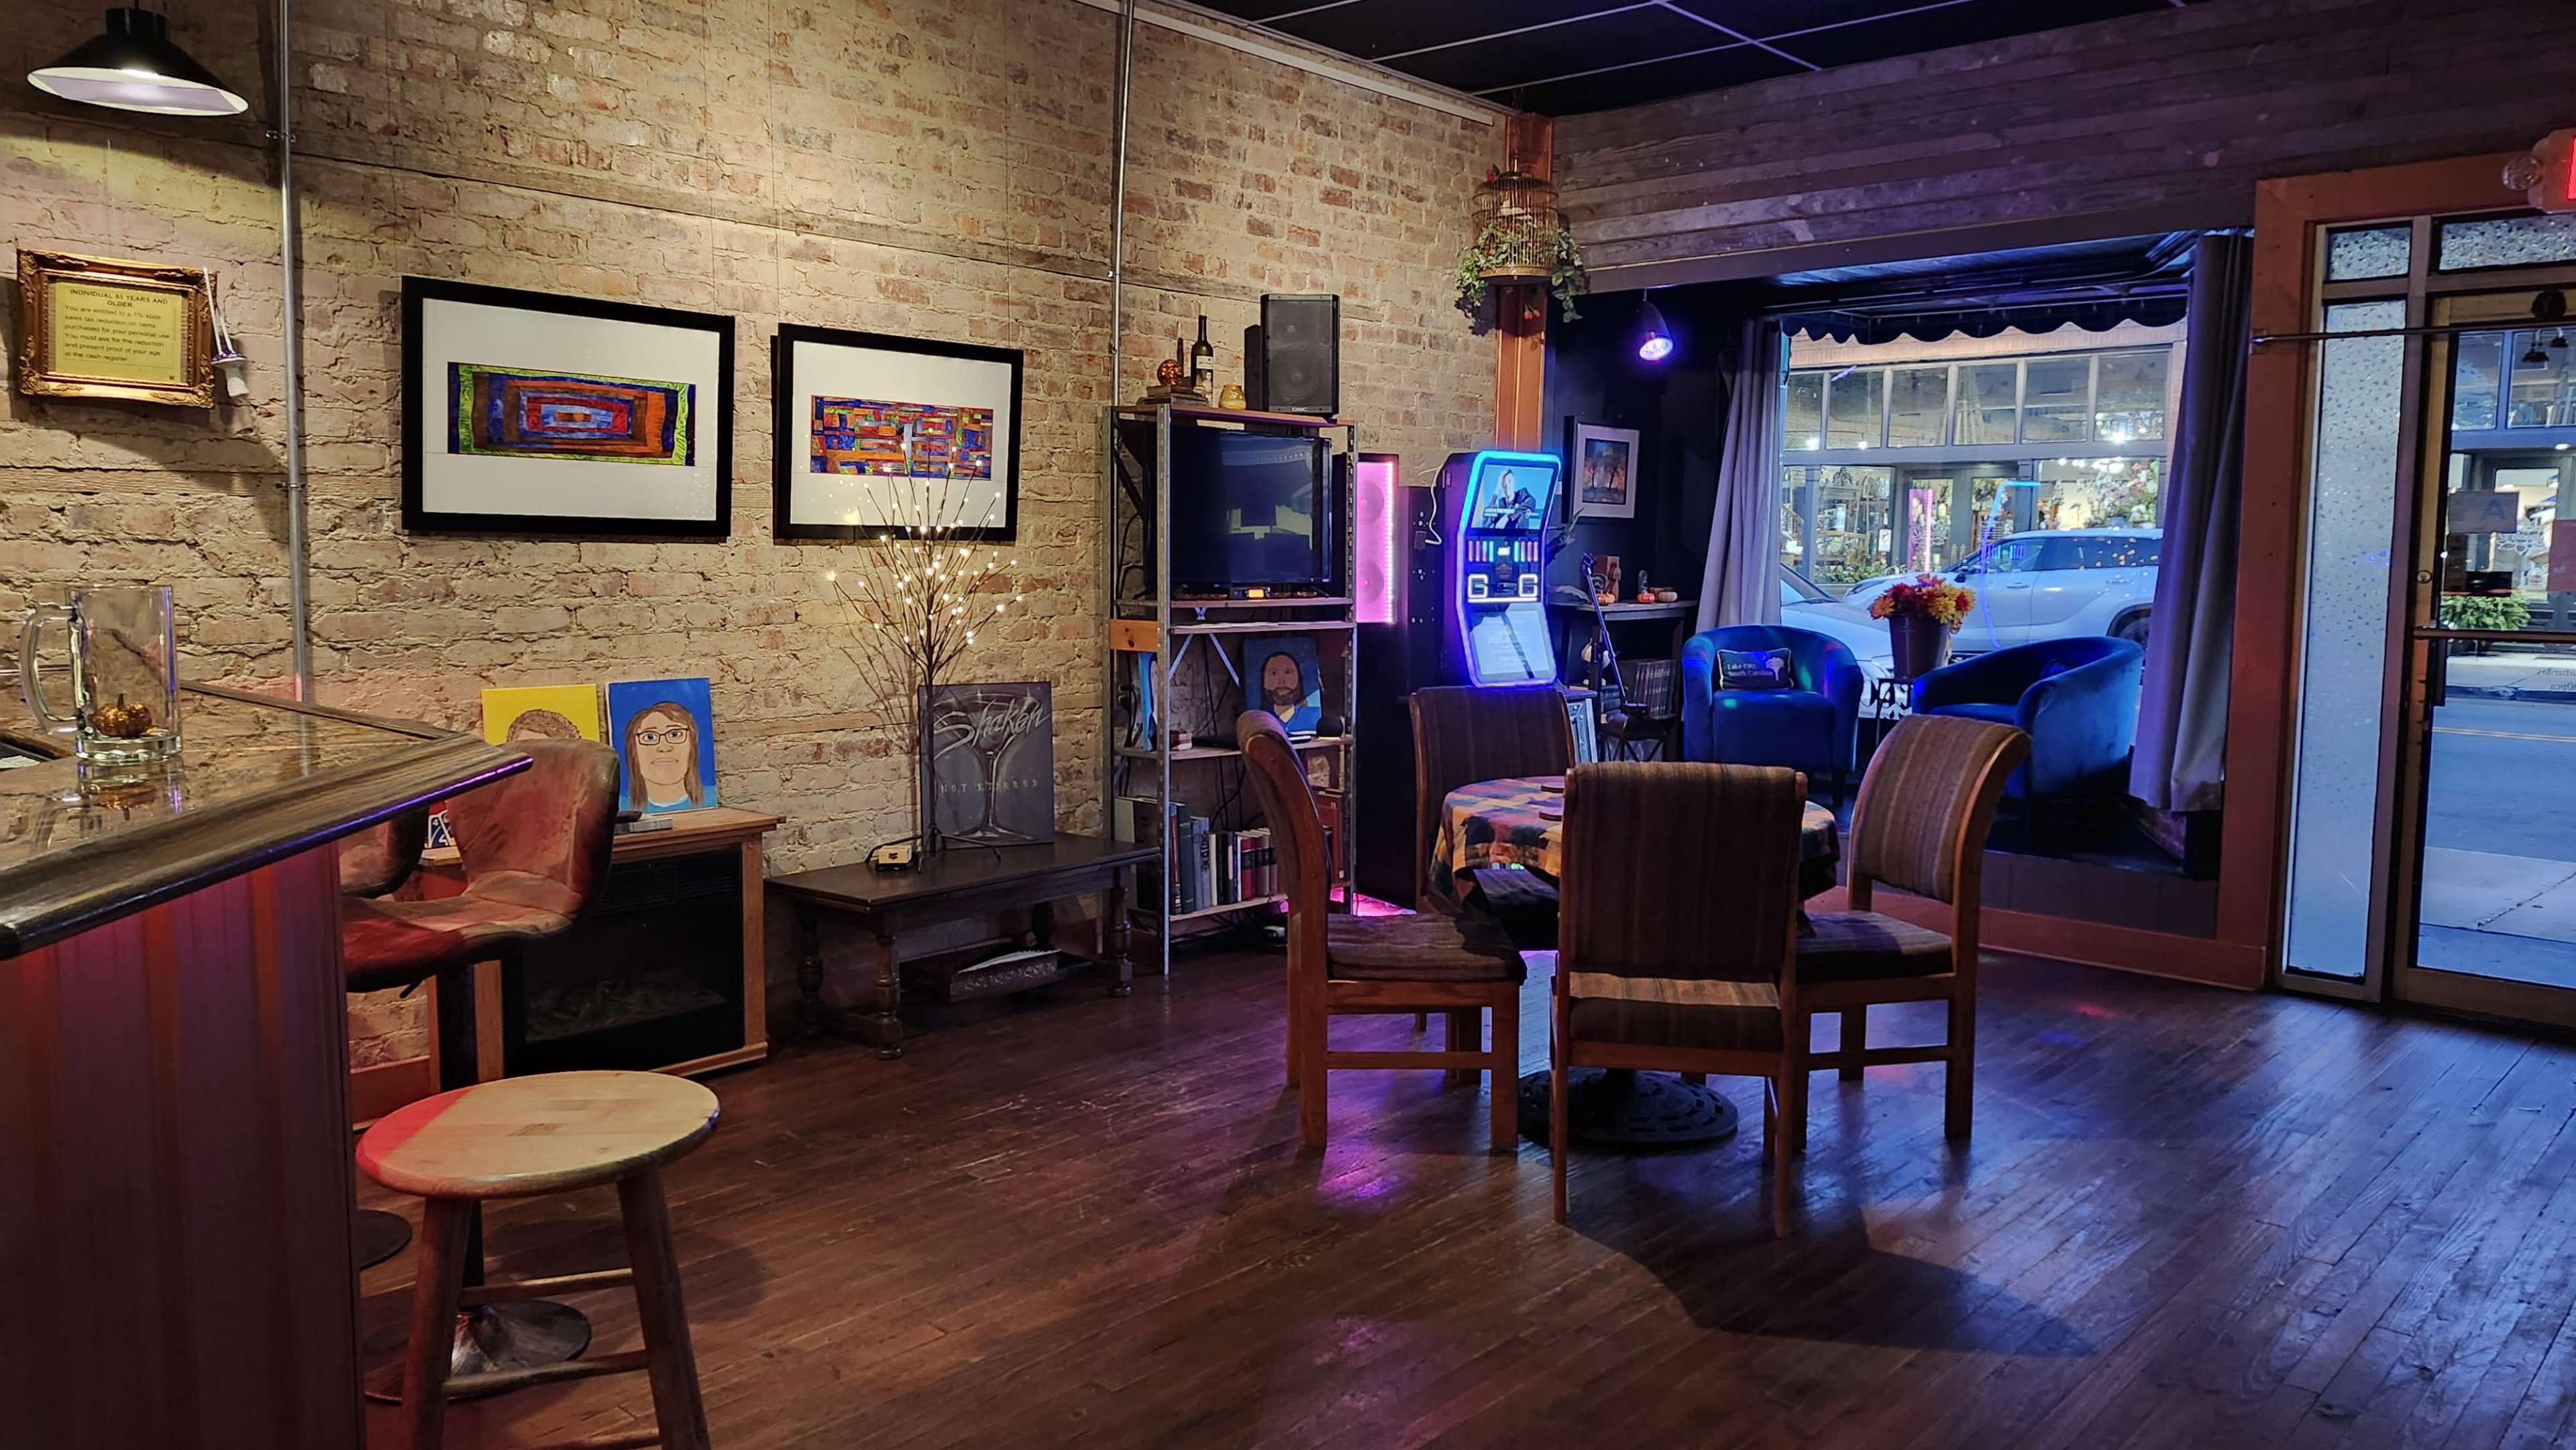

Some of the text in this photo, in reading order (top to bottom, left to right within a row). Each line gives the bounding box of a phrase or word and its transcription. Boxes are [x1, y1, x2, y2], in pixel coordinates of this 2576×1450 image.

[70, 289, 112, 298] INDIVIDUAL
[125, 294, 150, 302] YEARS
[93, 307, 117, 315] entitled
[97, 317, 127, 326] reduction
[64, 324, 100, 333] purchased
[112, 328, 127, 336] your
[128, 329, 156, 338] personal
[135, 338, 164, 347] reduction
[106, 345, 123, 353] proof
[933, 698, 1051, 760] Shaken
[940, 783, 967, 793] NOT
[432, 818, 439, 826] 4
